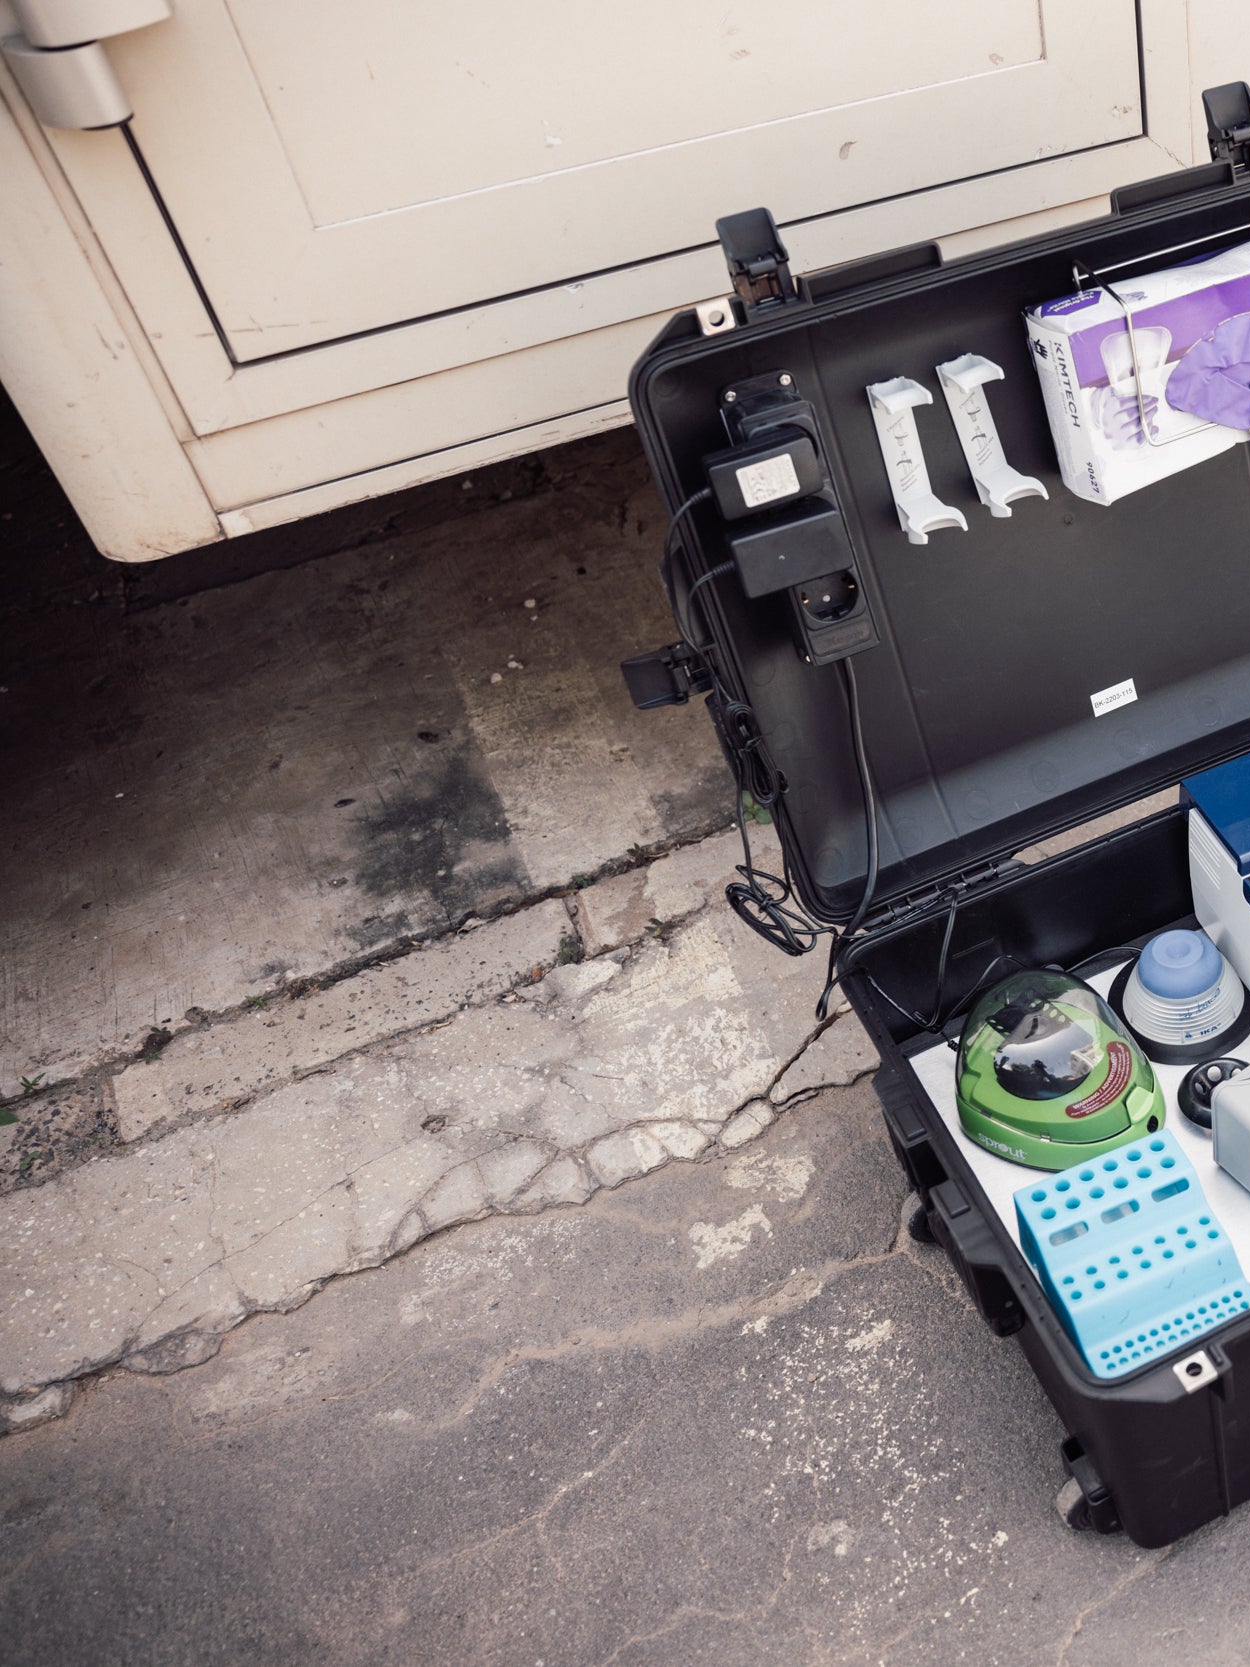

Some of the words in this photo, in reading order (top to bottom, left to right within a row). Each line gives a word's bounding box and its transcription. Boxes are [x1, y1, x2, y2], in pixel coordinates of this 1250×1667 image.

[1054, 341, 1081, 428] KIMTECH
[1086, 461, 1100, 494] 90627
[1200, 1025, 1218, 1036] IKA
[1073, 1091, 1101, 1109] WARNING
[978, 1132, 1027, 1161] sprout
